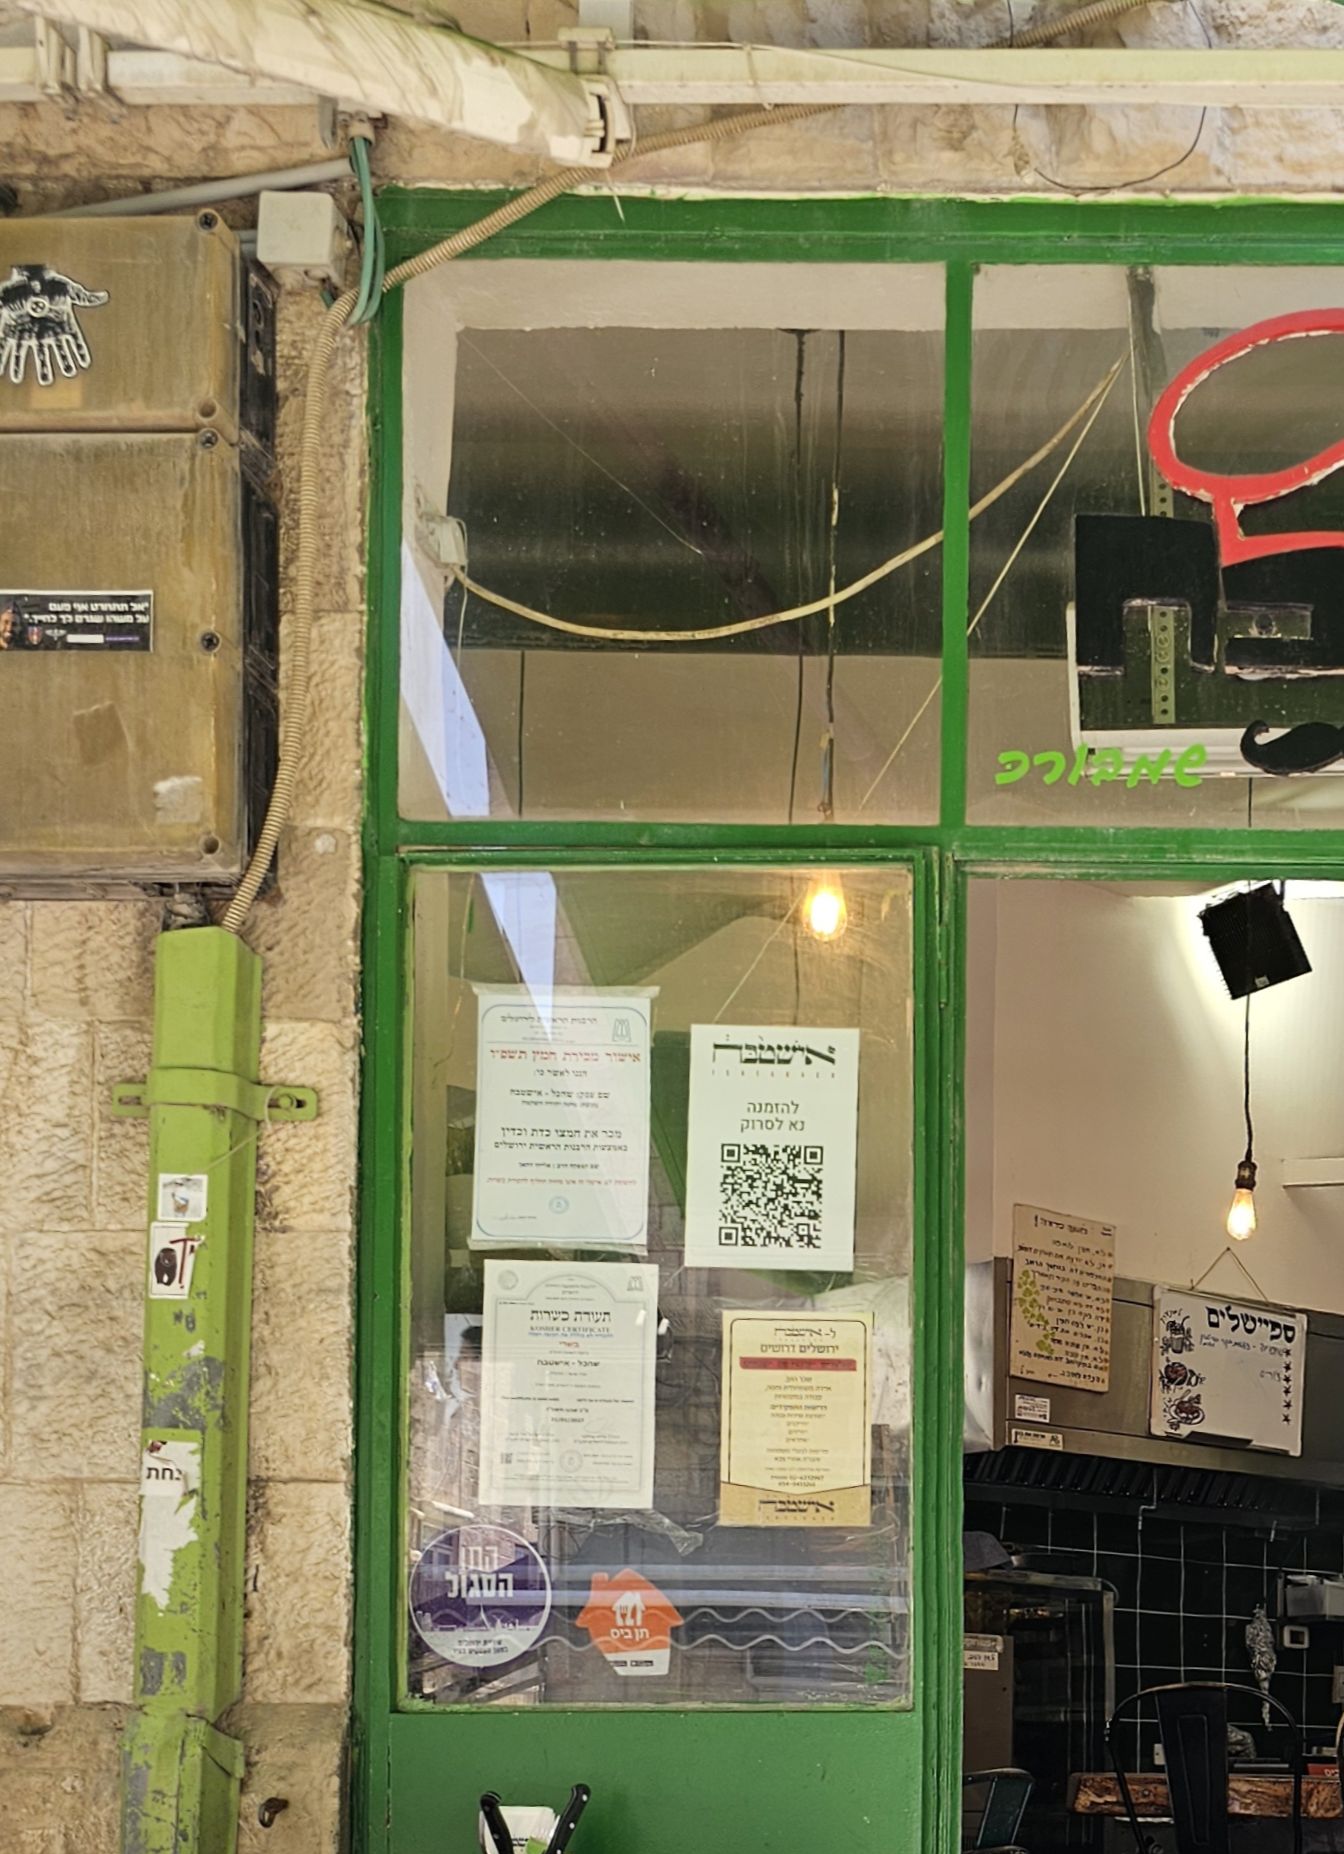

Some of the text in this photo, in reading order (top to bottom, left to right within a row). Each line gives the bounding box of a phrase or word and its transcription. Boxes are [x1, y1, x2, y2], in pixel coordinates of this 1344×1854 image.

[747, 1101, 800, 1115] להזמנה
[740, 1117, 806, 1134] נא לסרוק
[530, 1309, 612, 1323] תעודת כשרות
[1205, 1305, 1296, 1344] ספיישלים
[799, 1341, 840, 1354] ירושלים
[445, 1571, 514, 1598] הסגול
[610, 1628, 650, 1641] תן ביס
